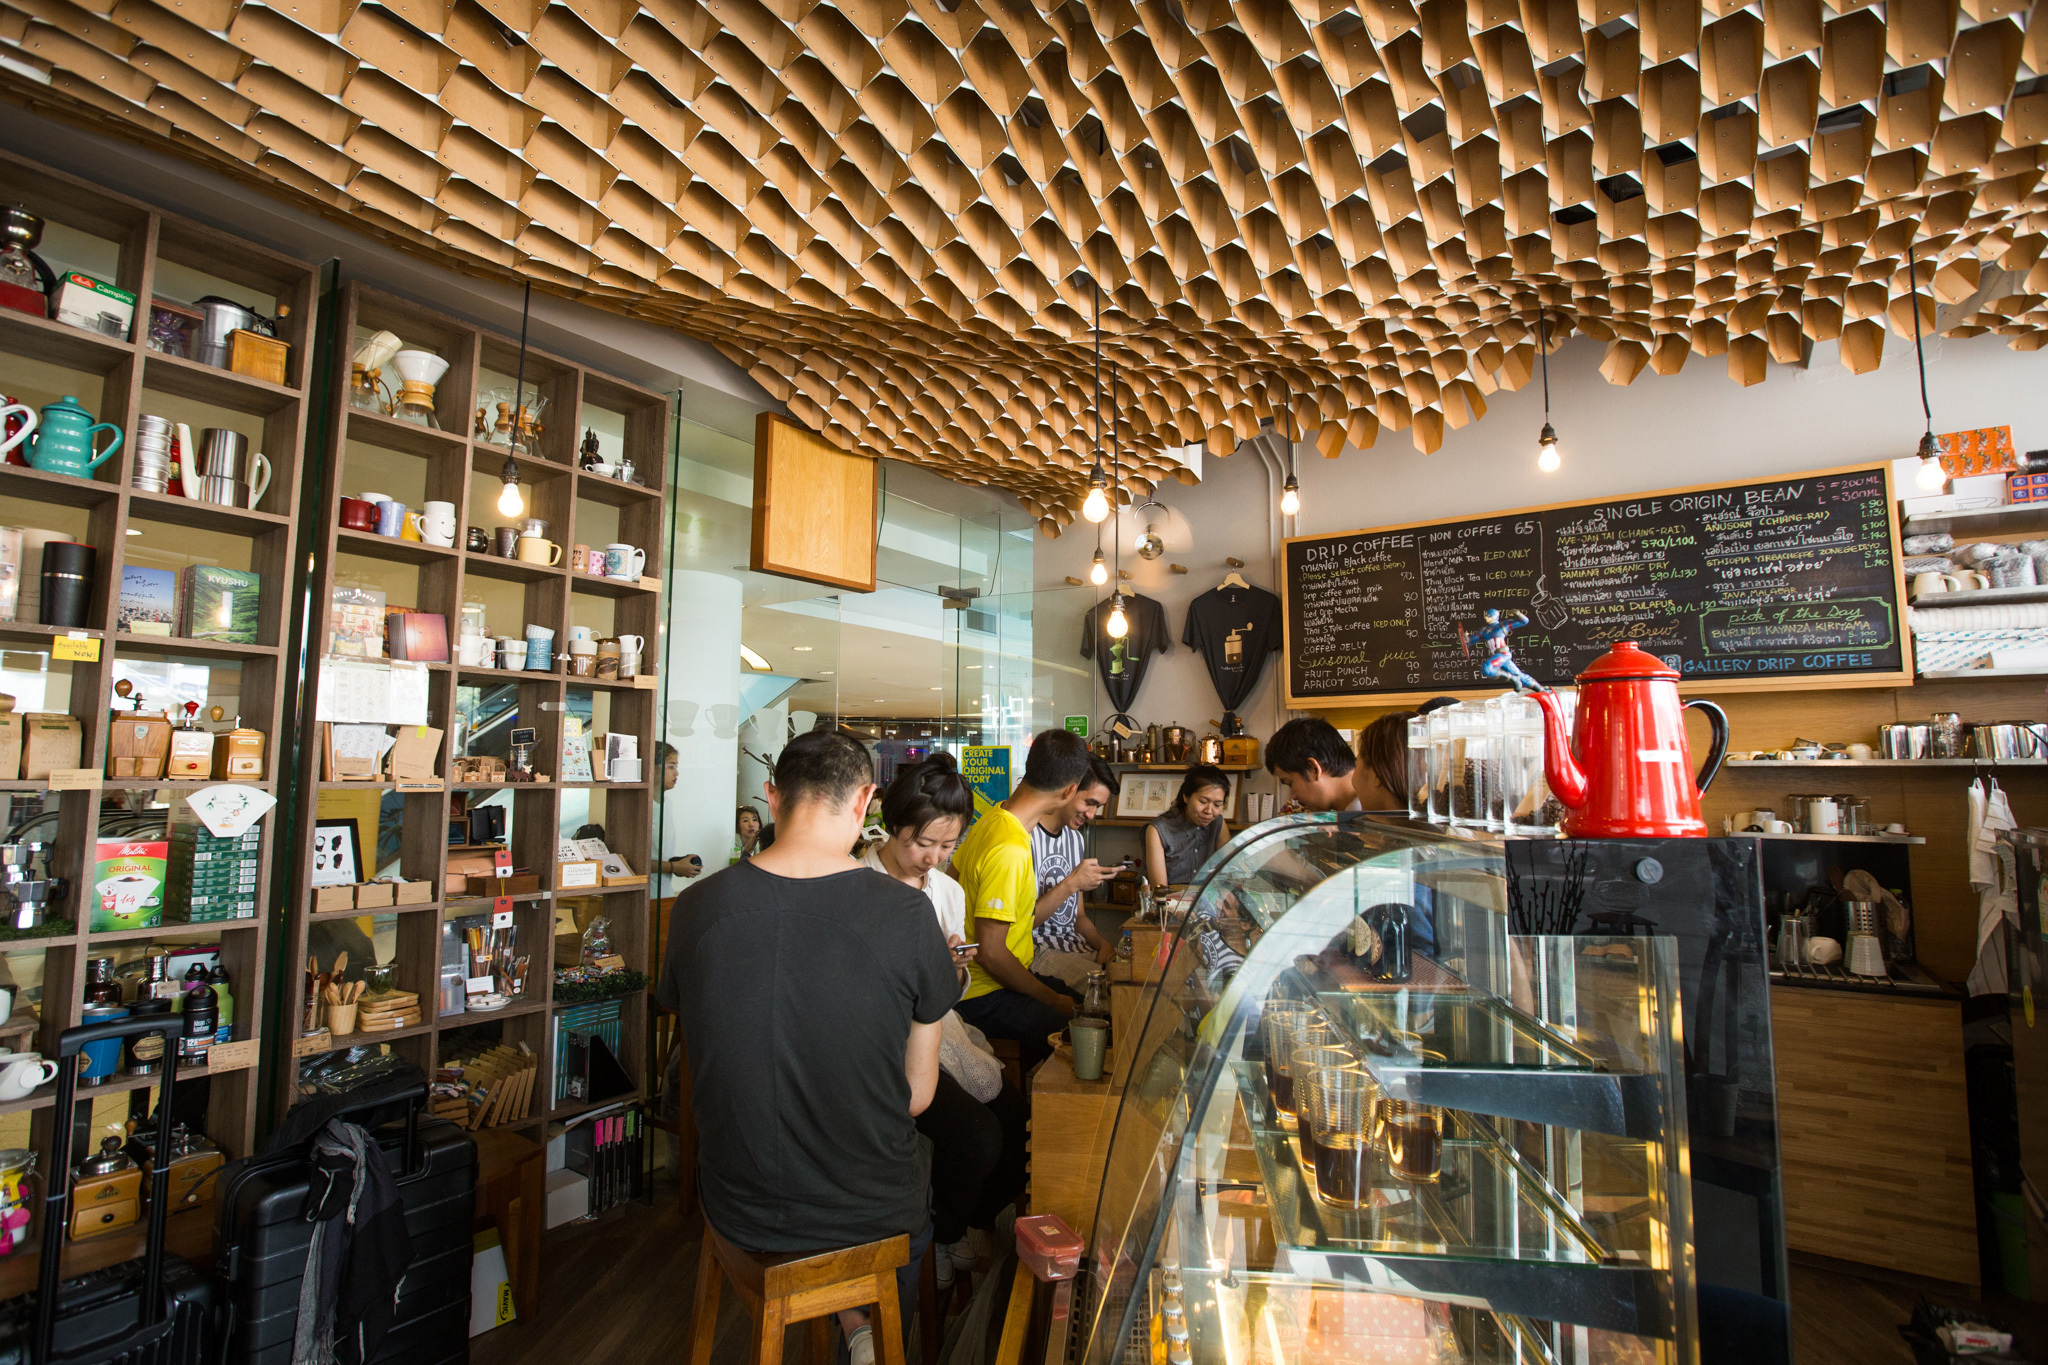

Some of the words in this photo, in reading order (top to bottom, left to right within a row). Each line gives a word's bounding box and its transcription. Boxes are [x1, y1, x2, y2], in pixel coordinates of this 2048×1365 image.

[96, 284, 133, 304] Camping
[1593, 501, 1663, 521] SINGLE
[1669, 492, 1732, 512] ORIGIN
[1744, 484, 1805, 505] BEAN
[1429, 530, 1452, 543] NON
[1457, 524, 1502, 538] COFFEE
[1514, 520, 1535, 535] 65
[1704, 520, 1752, 532] ANUSORN
[1602, 532, 1615, 540] TAI
[1306, 543, 1348, 561] DRIP
[1352, 534, 1414, 555] COFFEE
[1344, 554, 1367, 567] Black
[1368, 550, 1392, 563] coffee
[1466, 554, 1480, 563] Tea
[1483, 551, 1505, 561] ICED
[1507, 548, 1531, 558] ONLY
[1706, 556, 1751, 567] ETHIOPIA
[1357, 563, 1380, 574] coffee
[1468, 573, 1481, 581] Tea
[1485, 570, 1507, 580] ICED
[1509, 569, 1534, 578] ONLY
[1560, 568, 1600, 580] PAMIANG
[1604, 563, 1645, 575] ORGANIC
[1649, 561, 1671, 571] DRY
[208, 574, 249, 588] KYUSHU
[1320, 587, 1342, 598] coffee
[1346, 586, 1362, 595] with
[1366, 584, 1383, 593] milk
[1458, 590, 1481, 600] Latte
[1484, 588, 1530, 598] HOT/ICED
[1722, 590, 1746, 600] JAVA
[1750, 587, 1798, 597] MALABAR
[1303, 609, 1317, 619] Iced
[1334, 605, 1359, 615] Mocha
[1571, 606, 1592, 615] MAE
[1594, 605, 1607, 614] LA
[1629, 599, 1675, 611] DULAPUR
[1427, 613, 1446, 623] Plain
[1772, 606, 1790, 624] of
[1792, 607, 1822, 619] the
[1304, 627, 1320, 636] Thai
[1373, 620, 1389, 629] ICED
[1389, 619, 1411, 627] ONLY
[1586, 622, 1628, 640] Cold
[1628, 618, 1680, 638] Brew
[1711, 627, 1762, 639] BURUNDI
[1765, 623, 1812, 634] KAYANZA
[1815, 620, 1871, 631] KIRIYAMA
[1339, 641, 1367, 652] JELLY
[1517, 634, 1551, 648] TEA
[74, 651, 96, 660] NOW!
[1298, 650, 1371, 669] Seasonal
[1379, 649, 1417, 668] juice
[1432, 649, 1484, 660] MALAYSAN
[1554, 657, 1570, 666] 95
[1683, 658, 1752, 673] GALLERY
[1757, 657, 1796, 671] DRIP
[1802, 653, 1873, 668] COFFEE
[1304, 669, 1333, 679] FRUIT
[1337, 666, 1368, 677] PUNCH
[1432, 671, 1470, 681] COFFEE
[1303, 678, 1345, 690] APRICOT
[1352, 676, 1380, 687] SODA
[1406, 673, 1421, 684] 65
[963, 749, 993, 758] CREATE
[963, 758, 989, 766] YOUR
[963, 766, 1006, 775] ORIGINAL
[973, 785, 996, 806] Thailand
[107, 864, 153, 873] ORIGINAL
[502, 1289, 510, 1315] MAVIC
